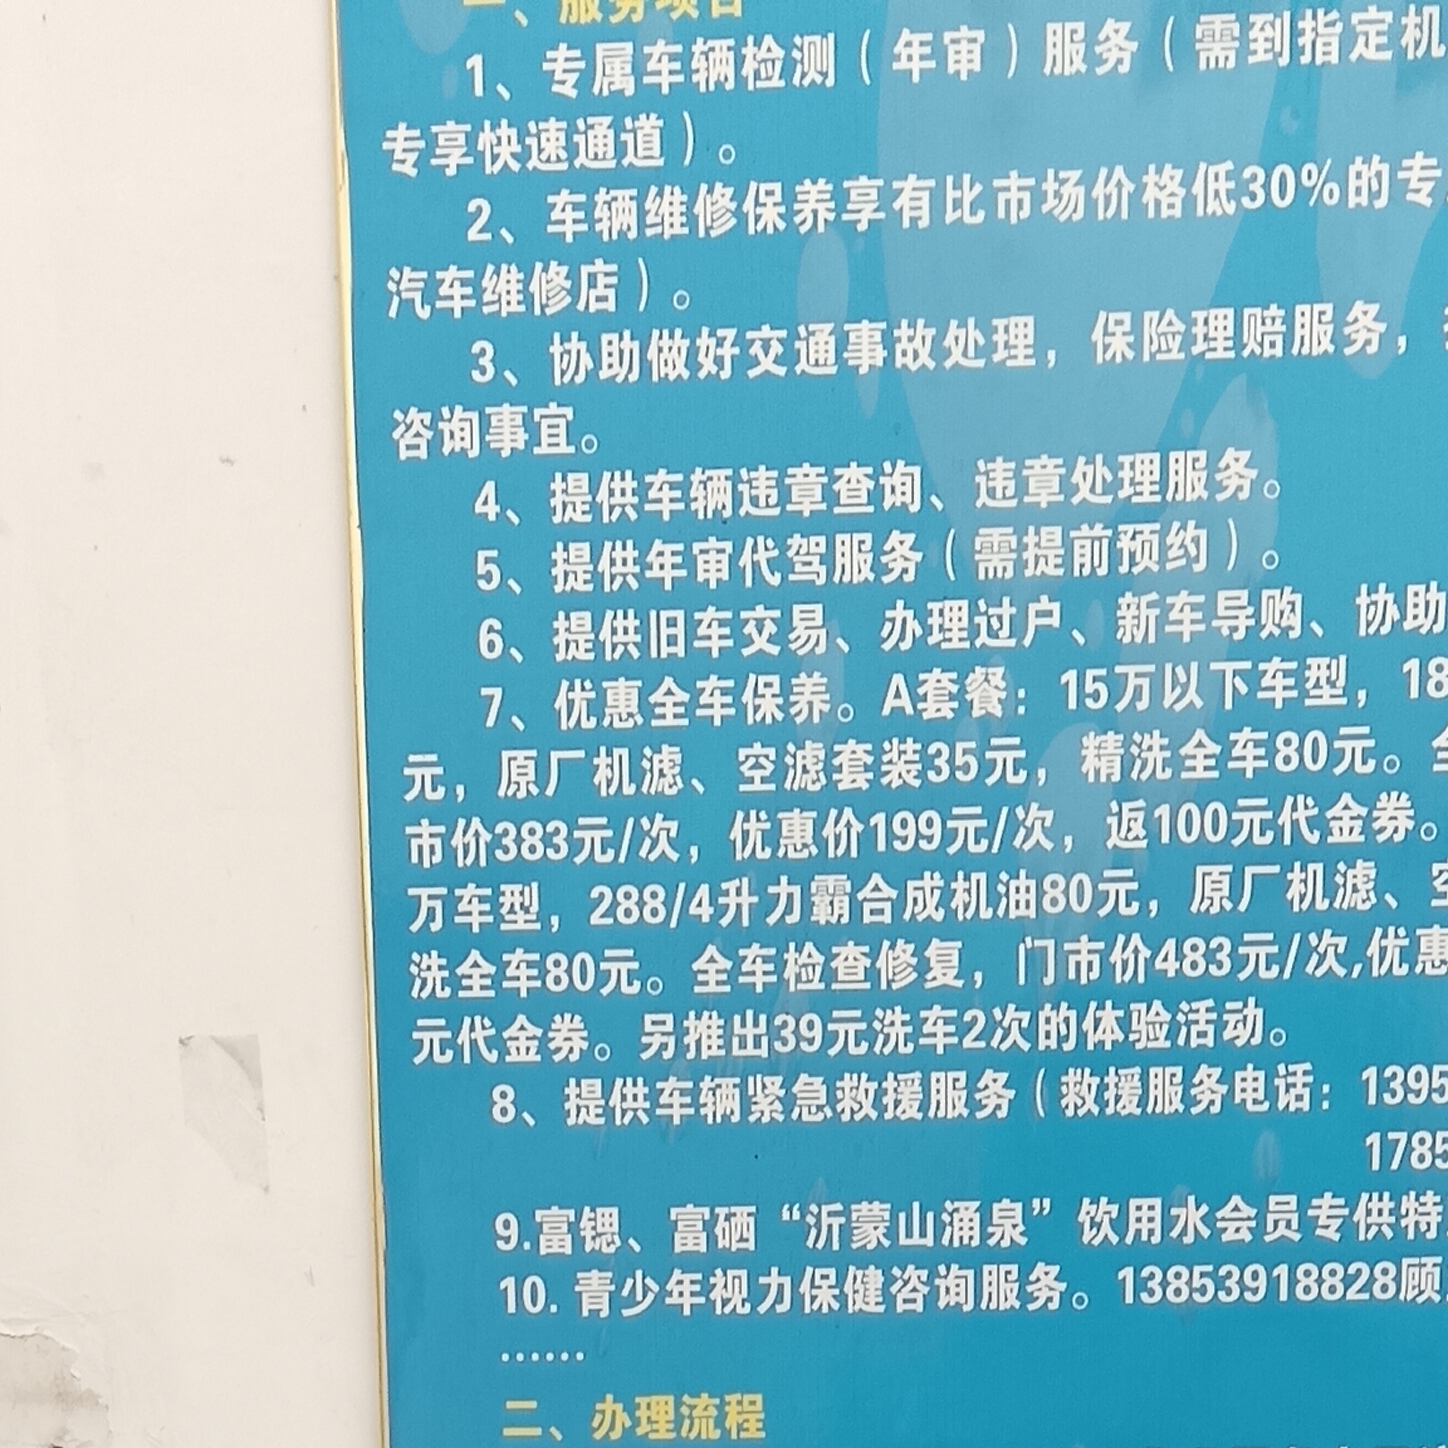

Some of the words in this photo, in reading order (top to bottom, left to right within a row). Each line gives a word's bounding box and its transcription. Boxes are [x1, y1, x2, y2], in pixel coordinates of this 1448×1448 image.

[382, 110, 735, 178] 专享快速通道）。
[387, 257, 690, 320] 汽车维修店）。
[392, 402, 597, 461] 咨询事宜。
[475, 447, 1280, 526] 4、提供车辆违章查询、违章处理服务。
[477, 518, 1279, 595] 5、提供年审代驾服务（需提前预约）。
[412, 996, 1286, 1065] 元代金券。另推出39元洗车2次的体验活动。
[503, 1393, 766, 1441] 二、办理流程
